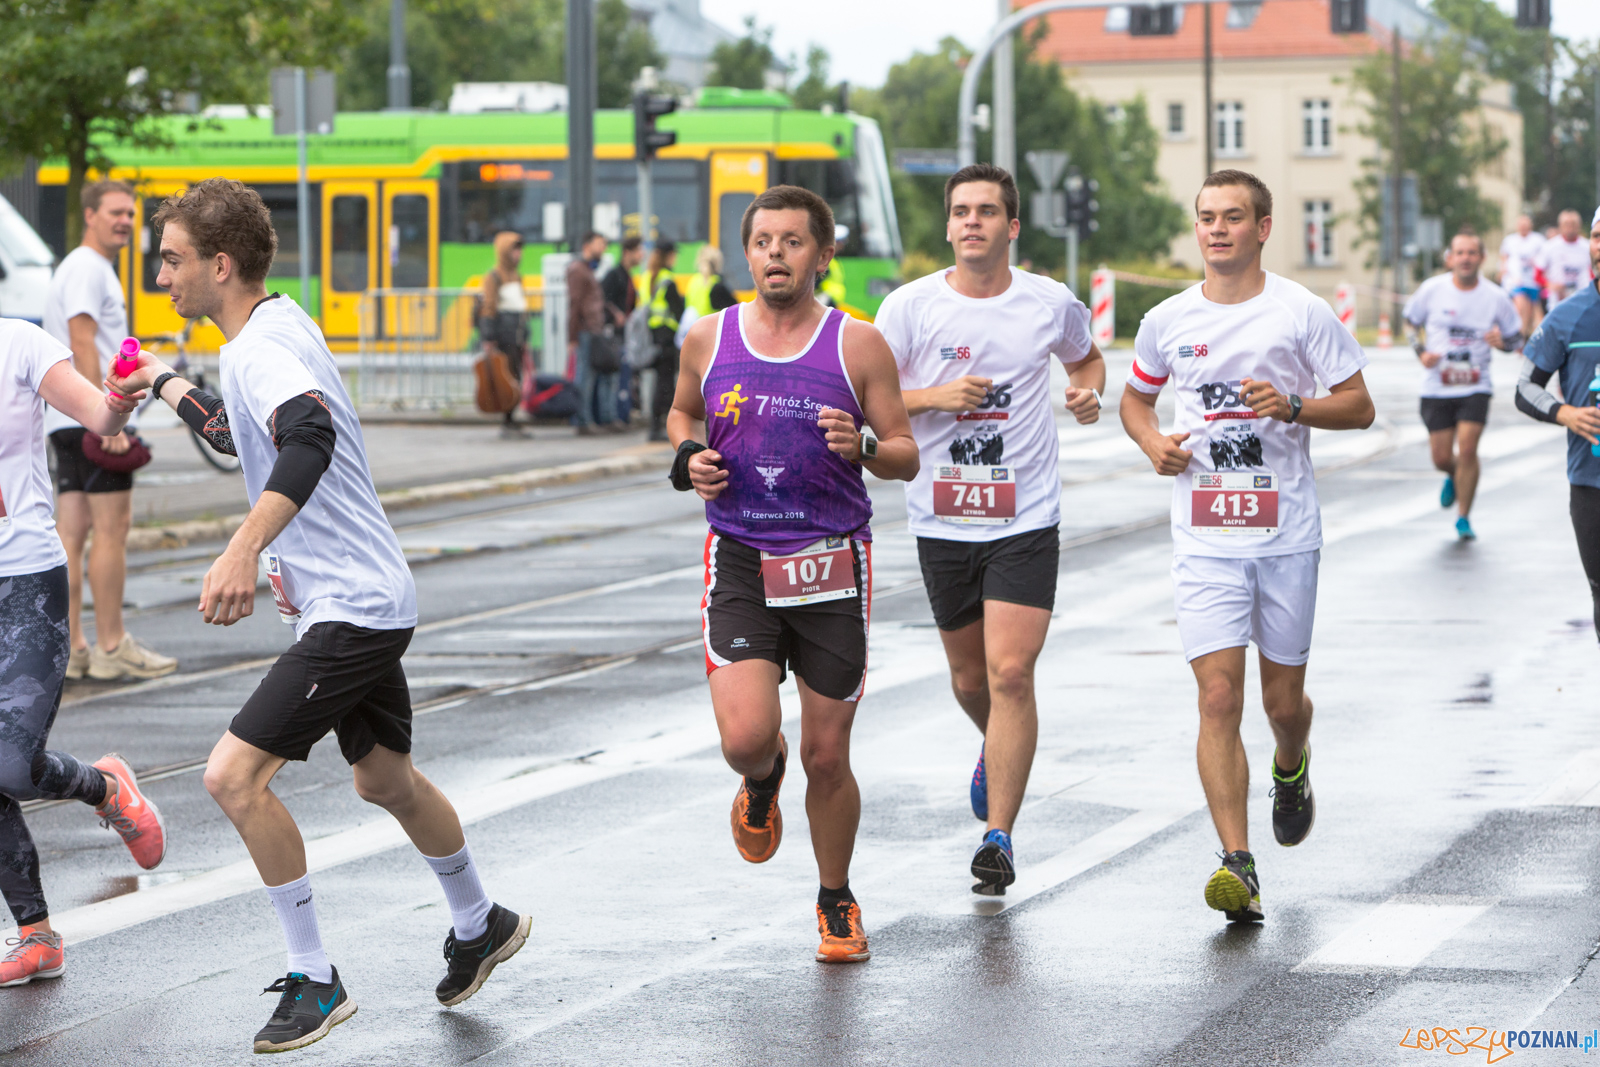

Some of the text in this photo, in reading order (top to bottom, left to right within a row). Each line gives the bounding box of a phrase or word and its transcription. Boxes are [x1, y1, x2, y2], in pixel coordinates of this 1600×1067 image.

[755, 395, 769, 415] 7
[771, 396, 801, 408] Mróz
[952, 484, 995, 508] 741
[1210, 493, 1260, 517] 413
[742, 510, 751, 518] 17
[784, 511, 805, 519] 2018
[781, 555, 834, 585] 107
[802, 585, 820, 594] PIOTR
